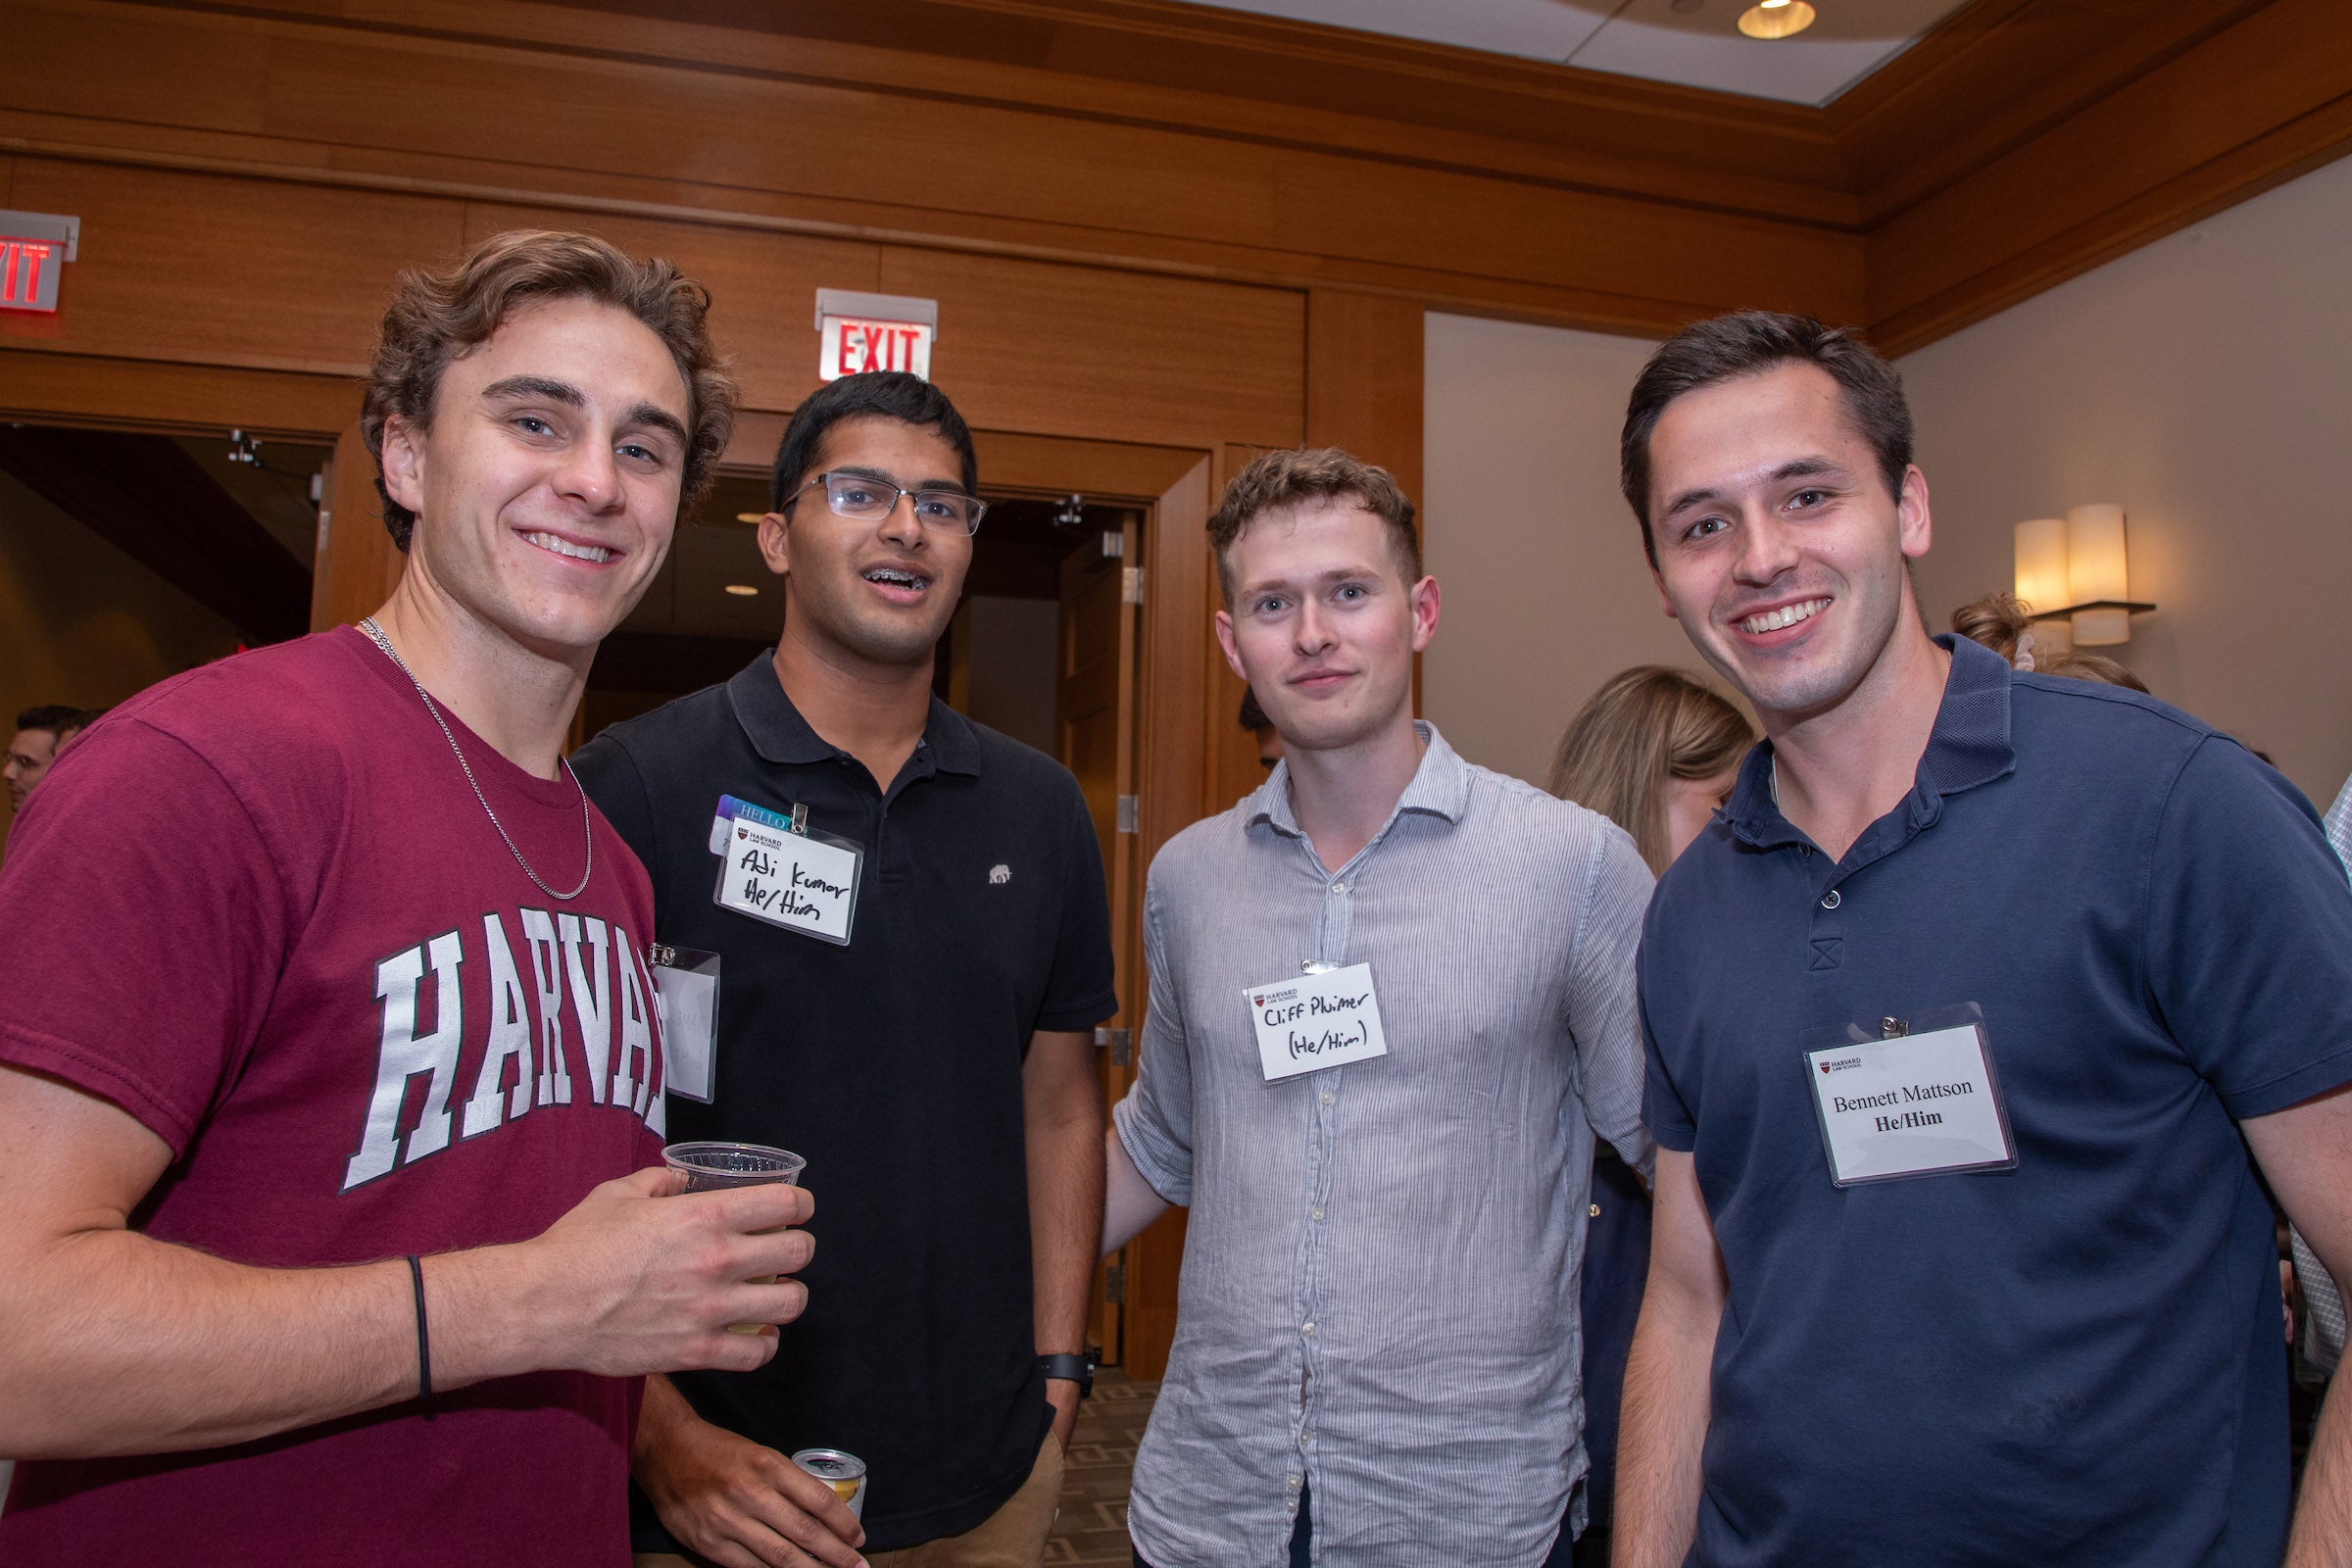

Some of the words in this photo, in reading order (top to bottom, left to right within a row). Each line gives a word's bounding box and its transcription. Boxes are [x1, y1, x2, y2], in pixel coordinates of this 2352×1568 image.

[0, 242, 50, 304] IT
[838, 320, 920, 375] EXIT
[740, 805, 785, 829] HELLO
[750, 832, 782, 847] HARVARD
[744, 878, 820, 920] He/Him
[1266, 989, 1298, 1000] HARVARD
[1290, 1019, 1367, 1059] (He/Him)
[1832, 1057, 1861, 1067] HARVARD
[1833, 1090, 1899, 1112] Bennett
[1901, 1080, 1974, 1103] Mattson
[1875, 1109, 1943, 1132] He/Him
